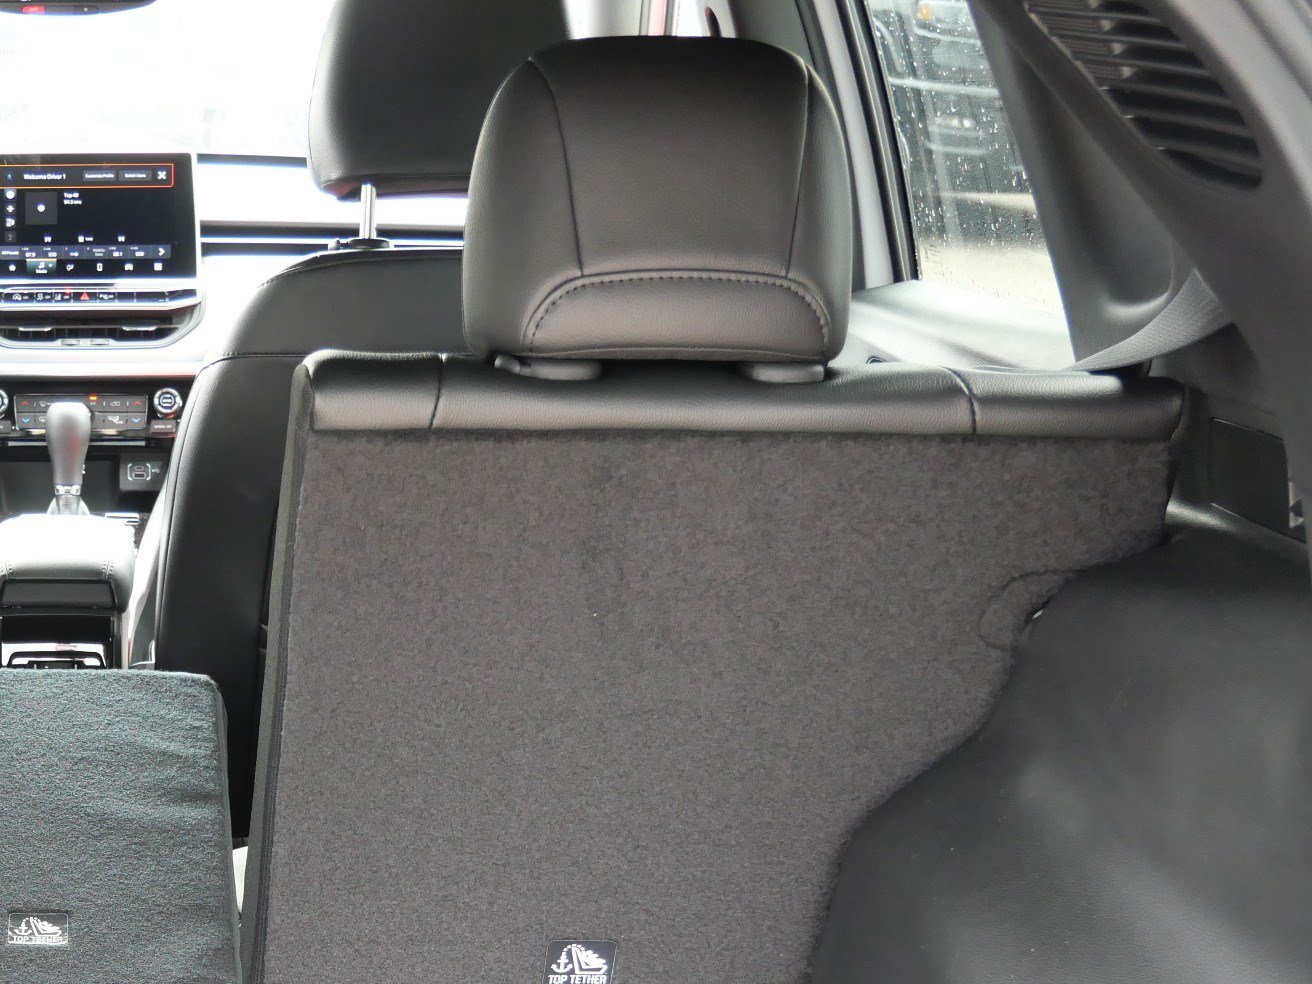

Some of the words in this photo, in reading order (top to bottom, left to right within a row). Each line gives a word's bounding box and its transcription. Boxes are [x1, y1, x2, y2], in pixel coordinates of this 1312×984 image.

[12, 935, 29, 943] TOP
[548, 974, 569, 984] TOP
[569, 974, 607, 984] TETHER
